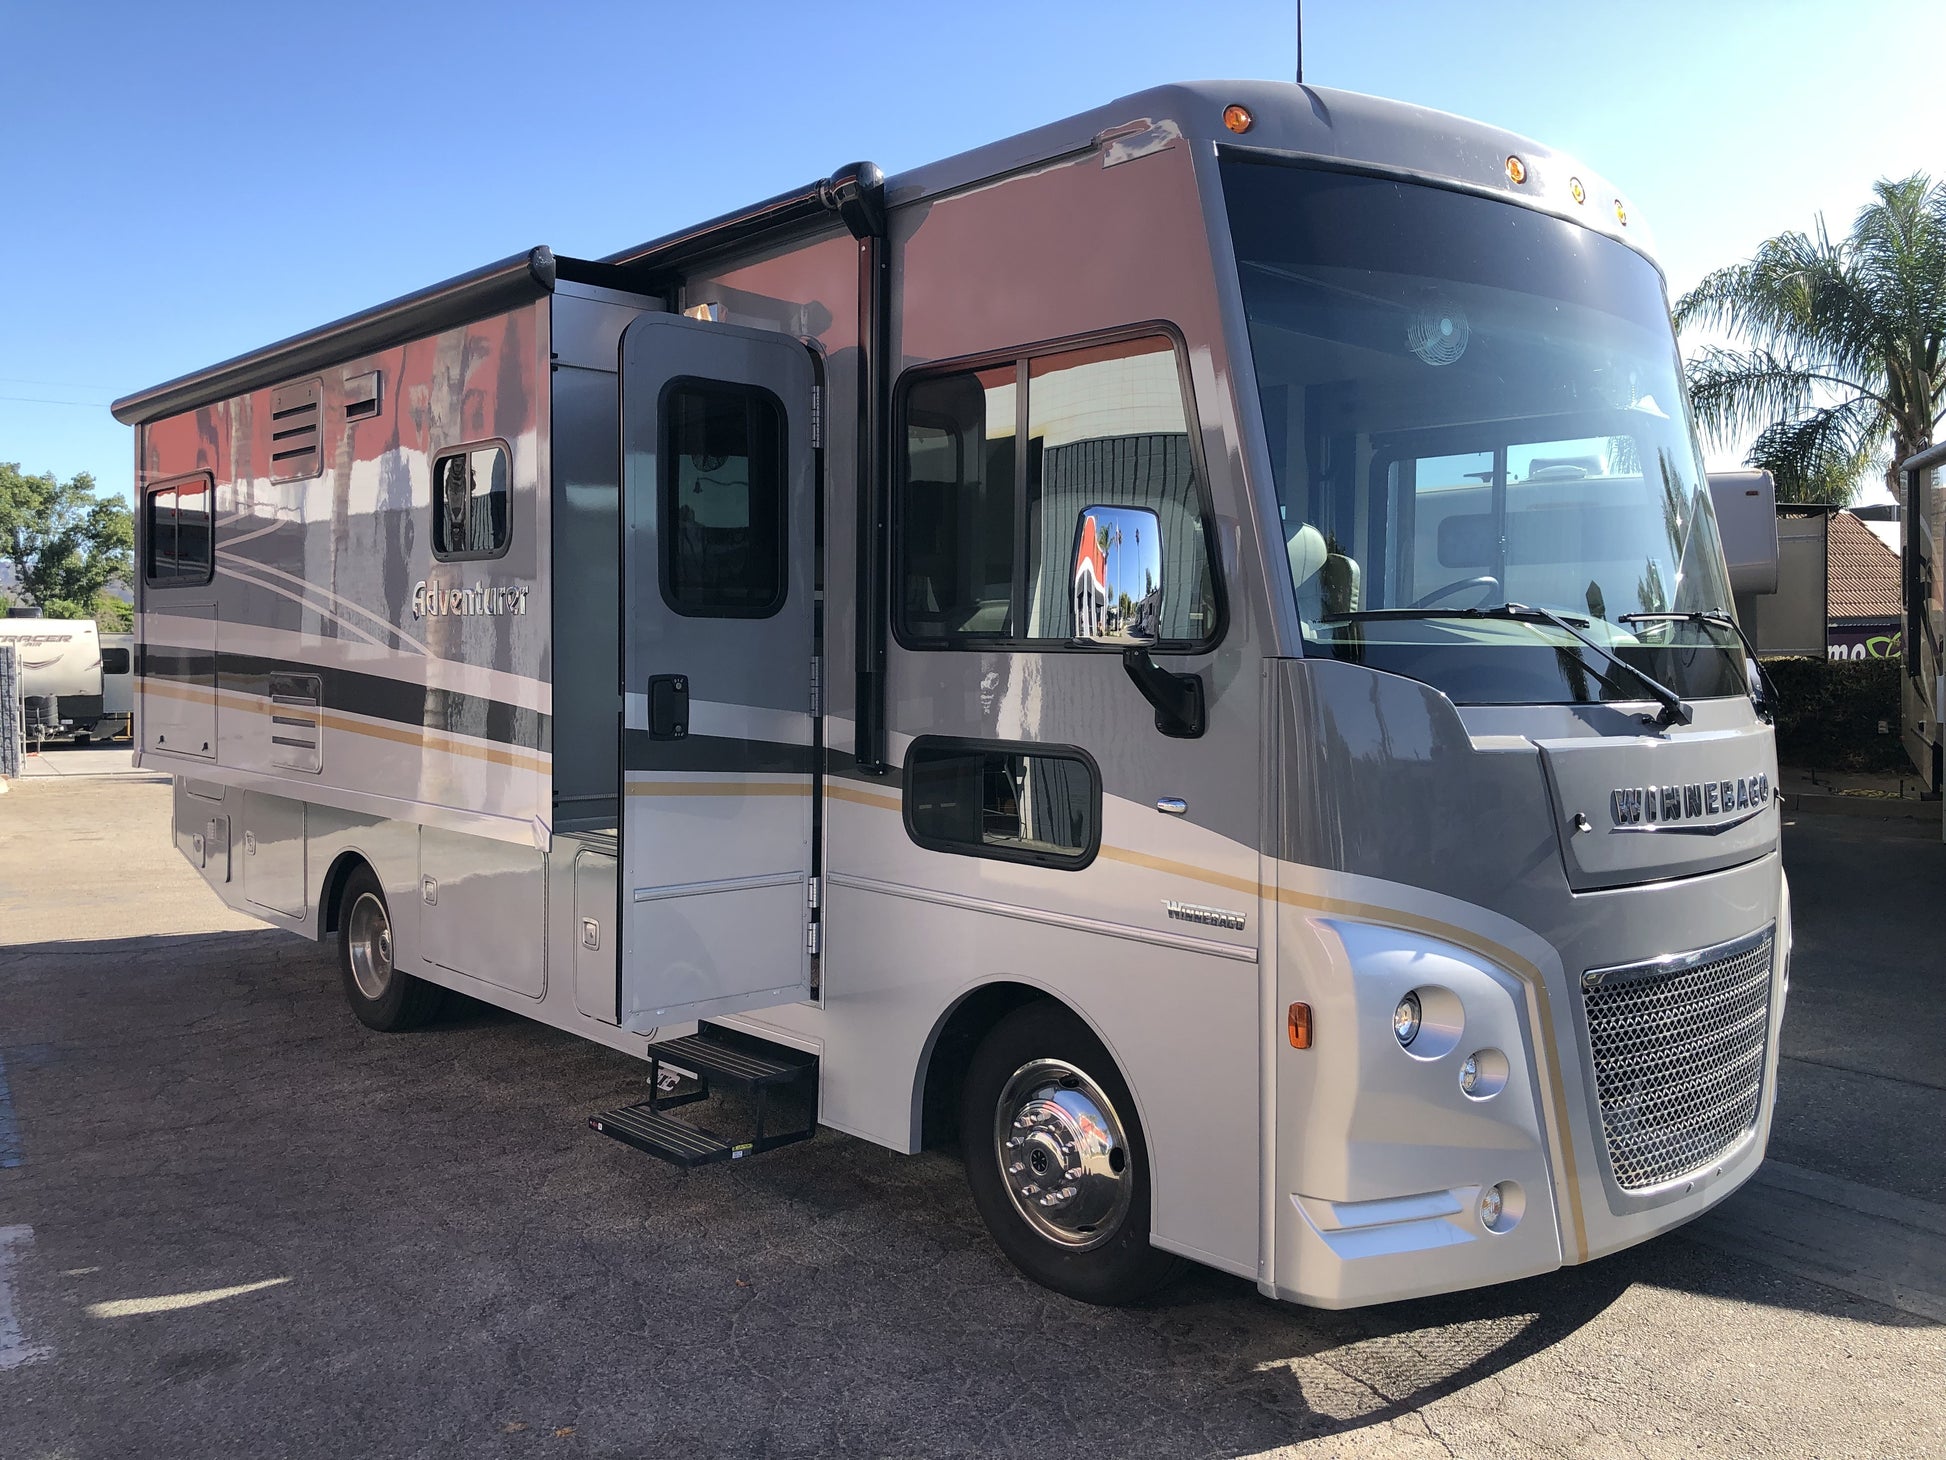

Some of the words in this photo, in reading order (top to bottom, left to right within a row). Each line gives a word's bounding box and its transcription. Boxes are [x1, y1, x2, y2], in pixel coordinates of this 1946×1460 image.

[412, 580, 529, 621] Adventurer
[1610, 772, 1769, 826] WINNEBAGO
[1164, 900, 1246, 931] WINNEBAGO
